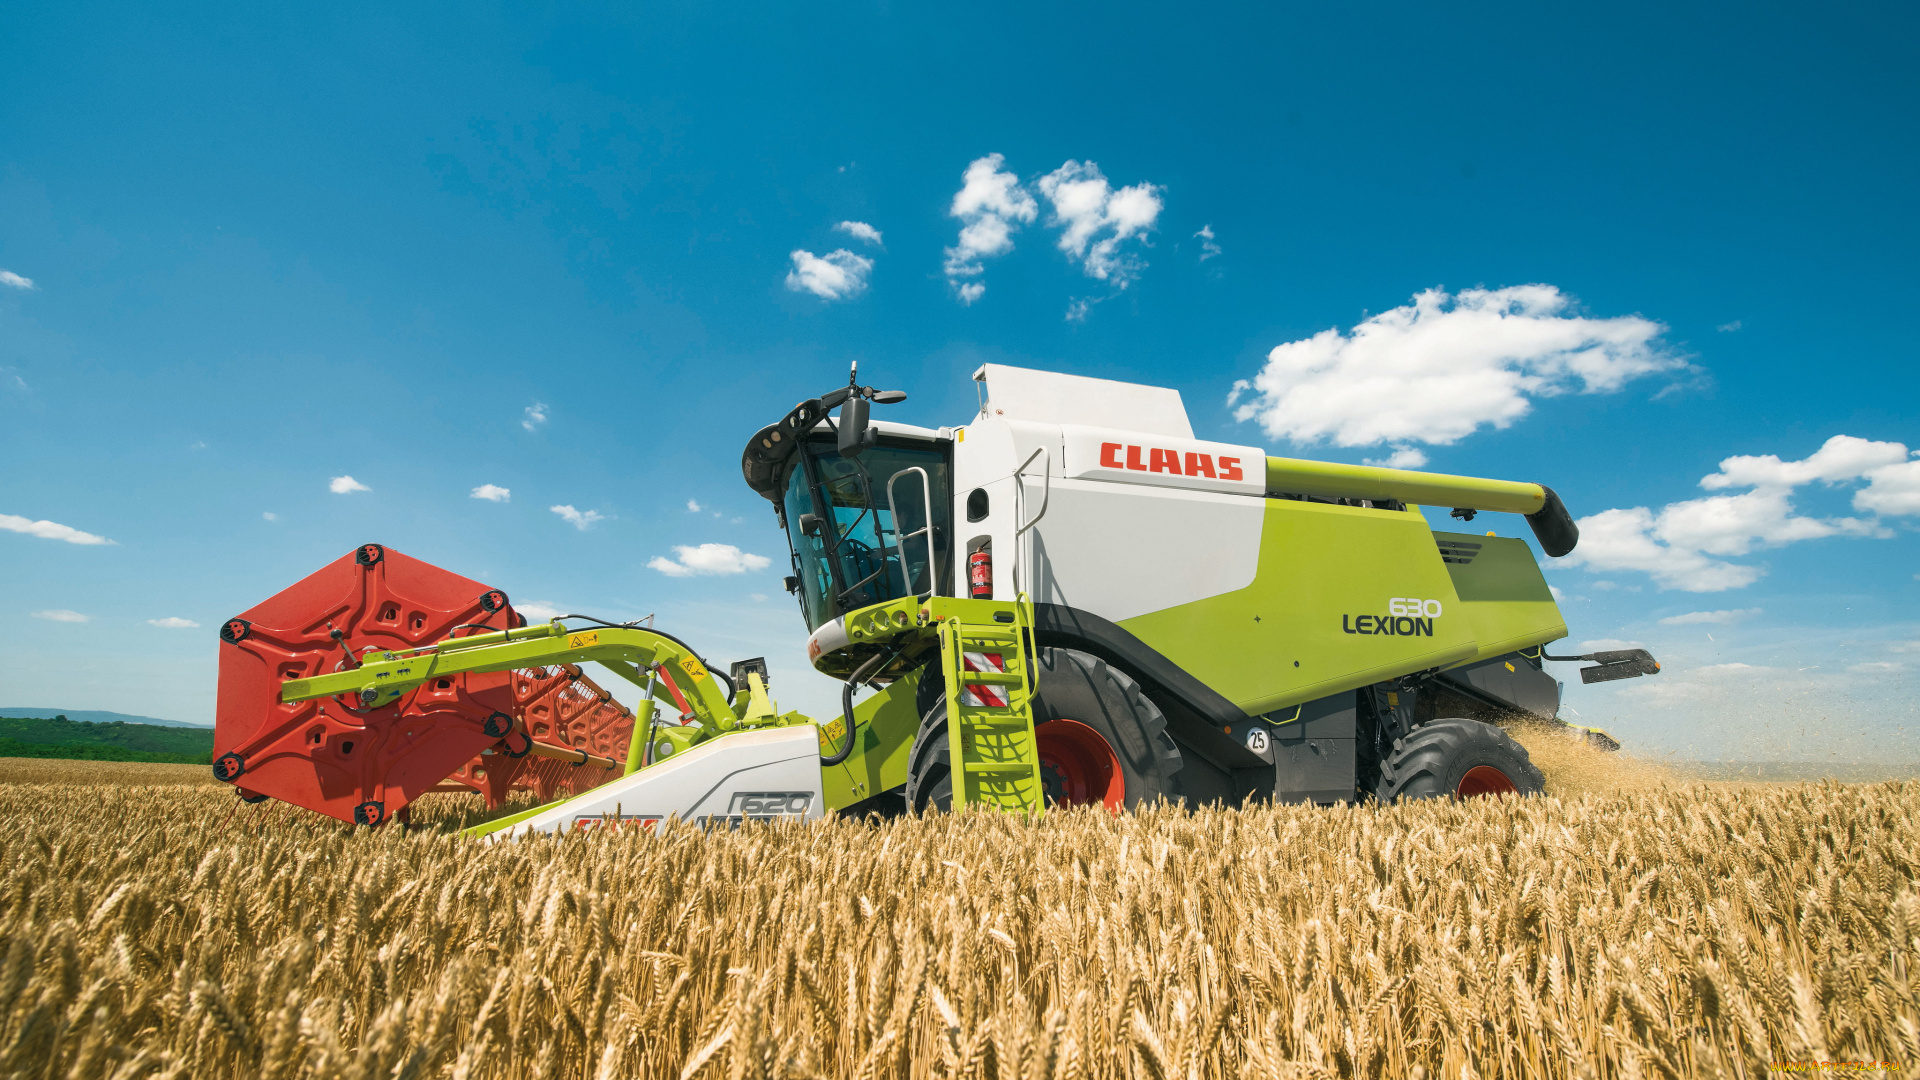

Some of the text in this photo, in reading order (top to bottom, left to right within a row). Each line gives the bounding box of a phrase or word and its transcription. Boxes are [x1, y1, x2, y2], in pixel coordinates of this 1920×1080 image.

[1100, 442, 1243, 481] CLAAS
[1389, 597, 1442, 618] 630
[1342, 614, 1433, 636] LEXION
[1251, 731, 1265, 749] 25
[740, 793, 811, 814] 620
